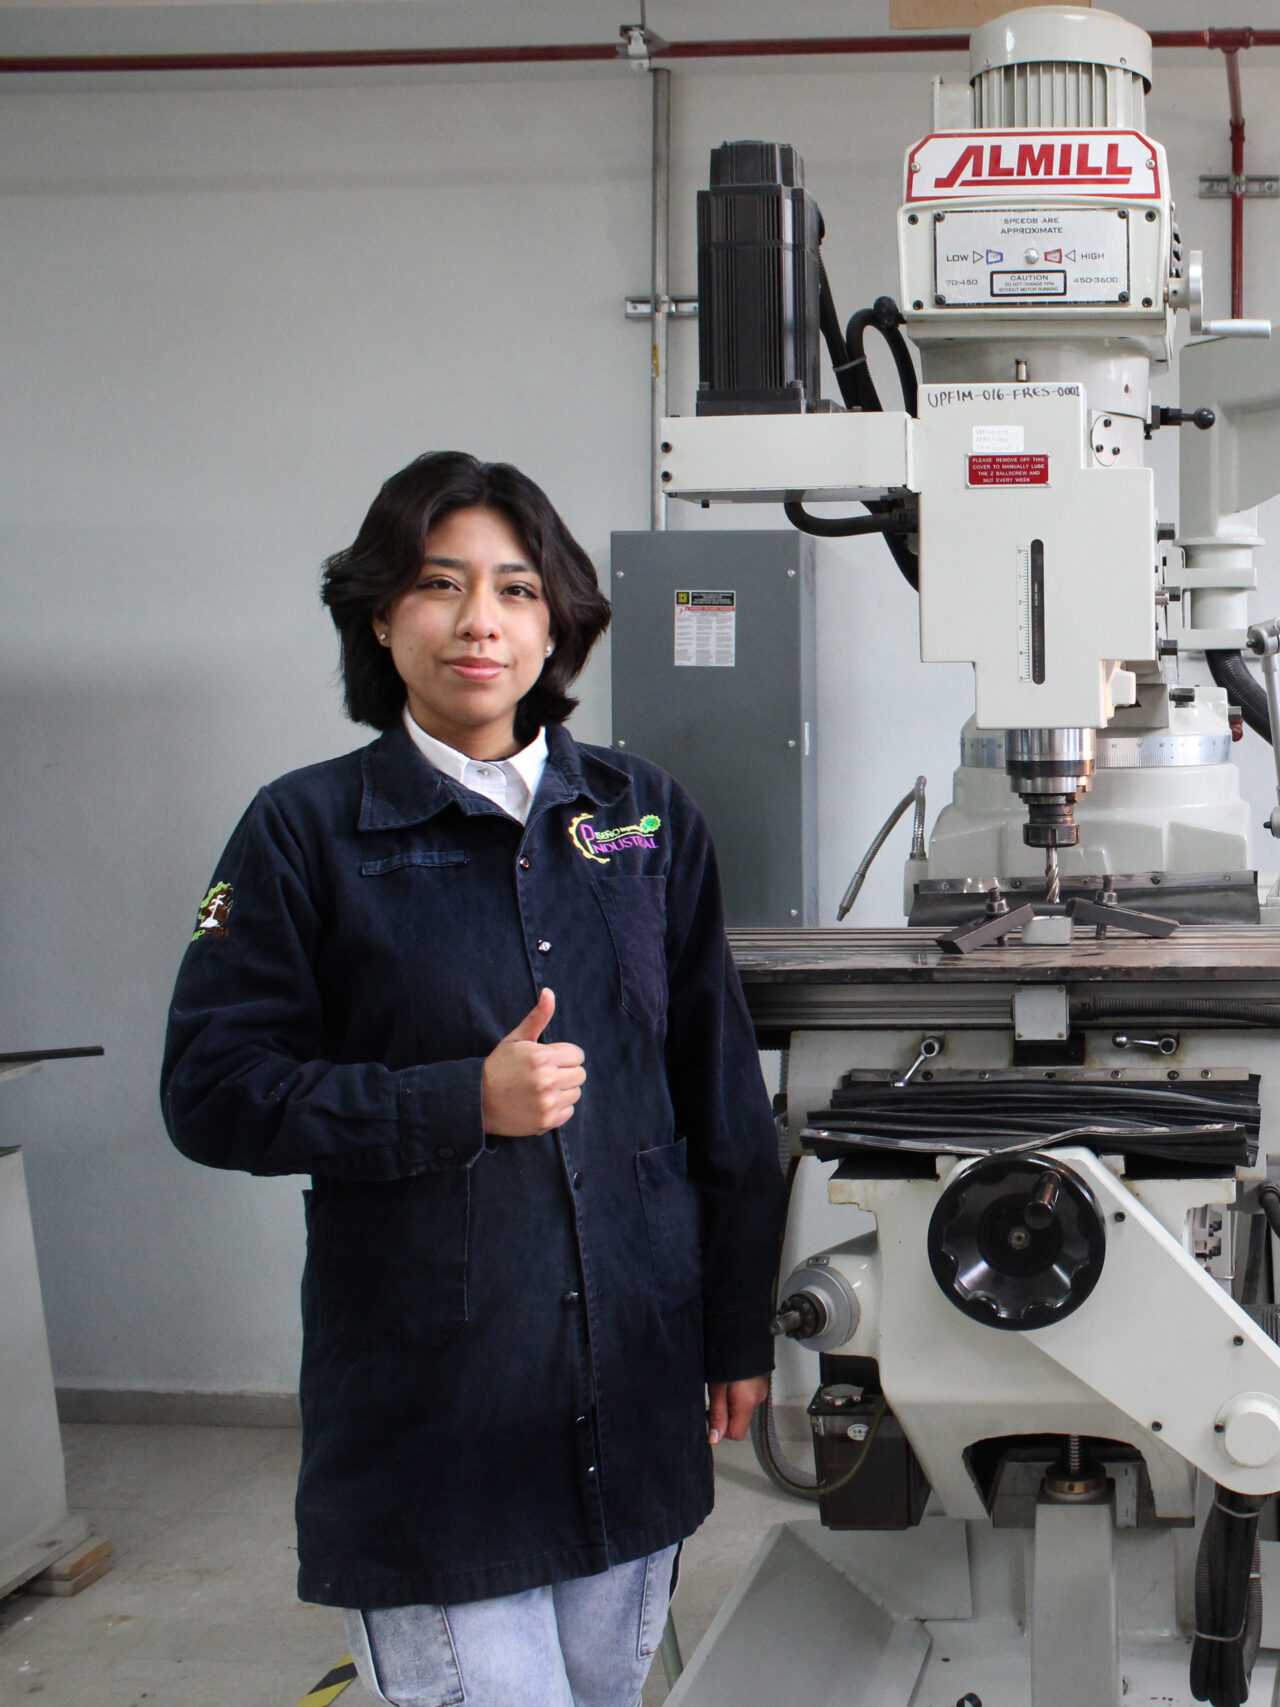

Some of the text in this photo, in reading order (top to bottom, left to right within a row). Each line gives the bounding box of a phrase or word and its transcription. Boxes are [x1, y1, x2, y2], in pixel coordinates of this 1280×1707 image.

[934, 144, 1132, 187] ALMILL
[1000, 226, 1064, 235] APPROXIMATE
[946, 254, 969, 263] LOW
[1081, 252, 1105, 261] HIGH
[1010, 274, 1049, 282] CAUTION
[1073, 276, 1119, 285] 450-3600
